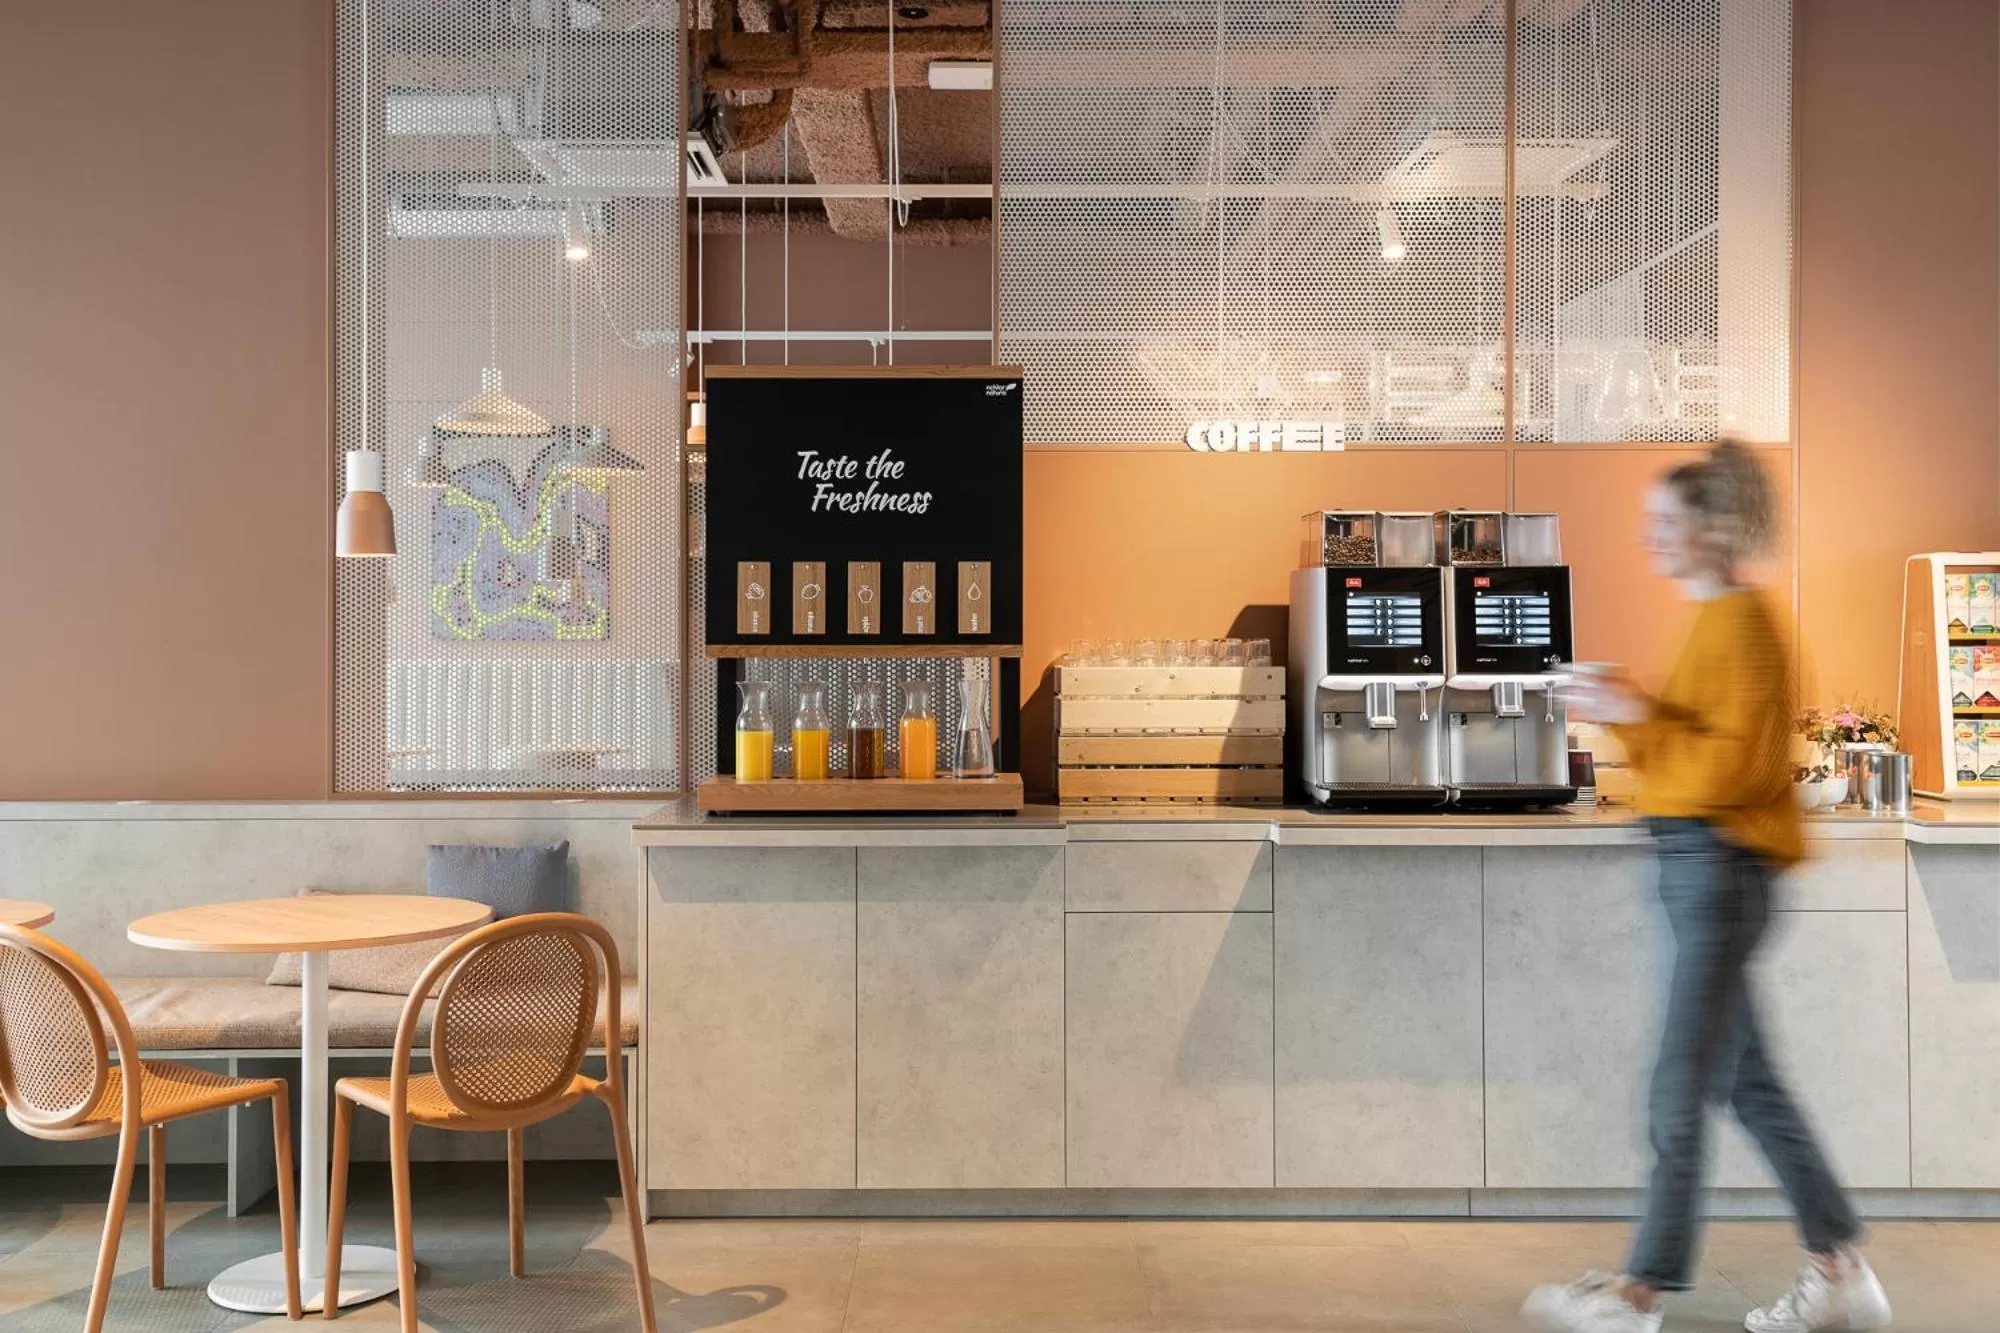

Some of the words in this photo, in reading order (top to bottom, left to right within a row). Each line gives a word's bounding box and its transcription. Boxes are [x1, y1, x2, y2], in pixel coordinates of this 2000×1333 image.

[1185, 420, 1345, 452] COFFEE
[797, 450, 859, 481] Taste
[865, 447, 905, 480] the
[811, 480, 933, 515] Freshness
